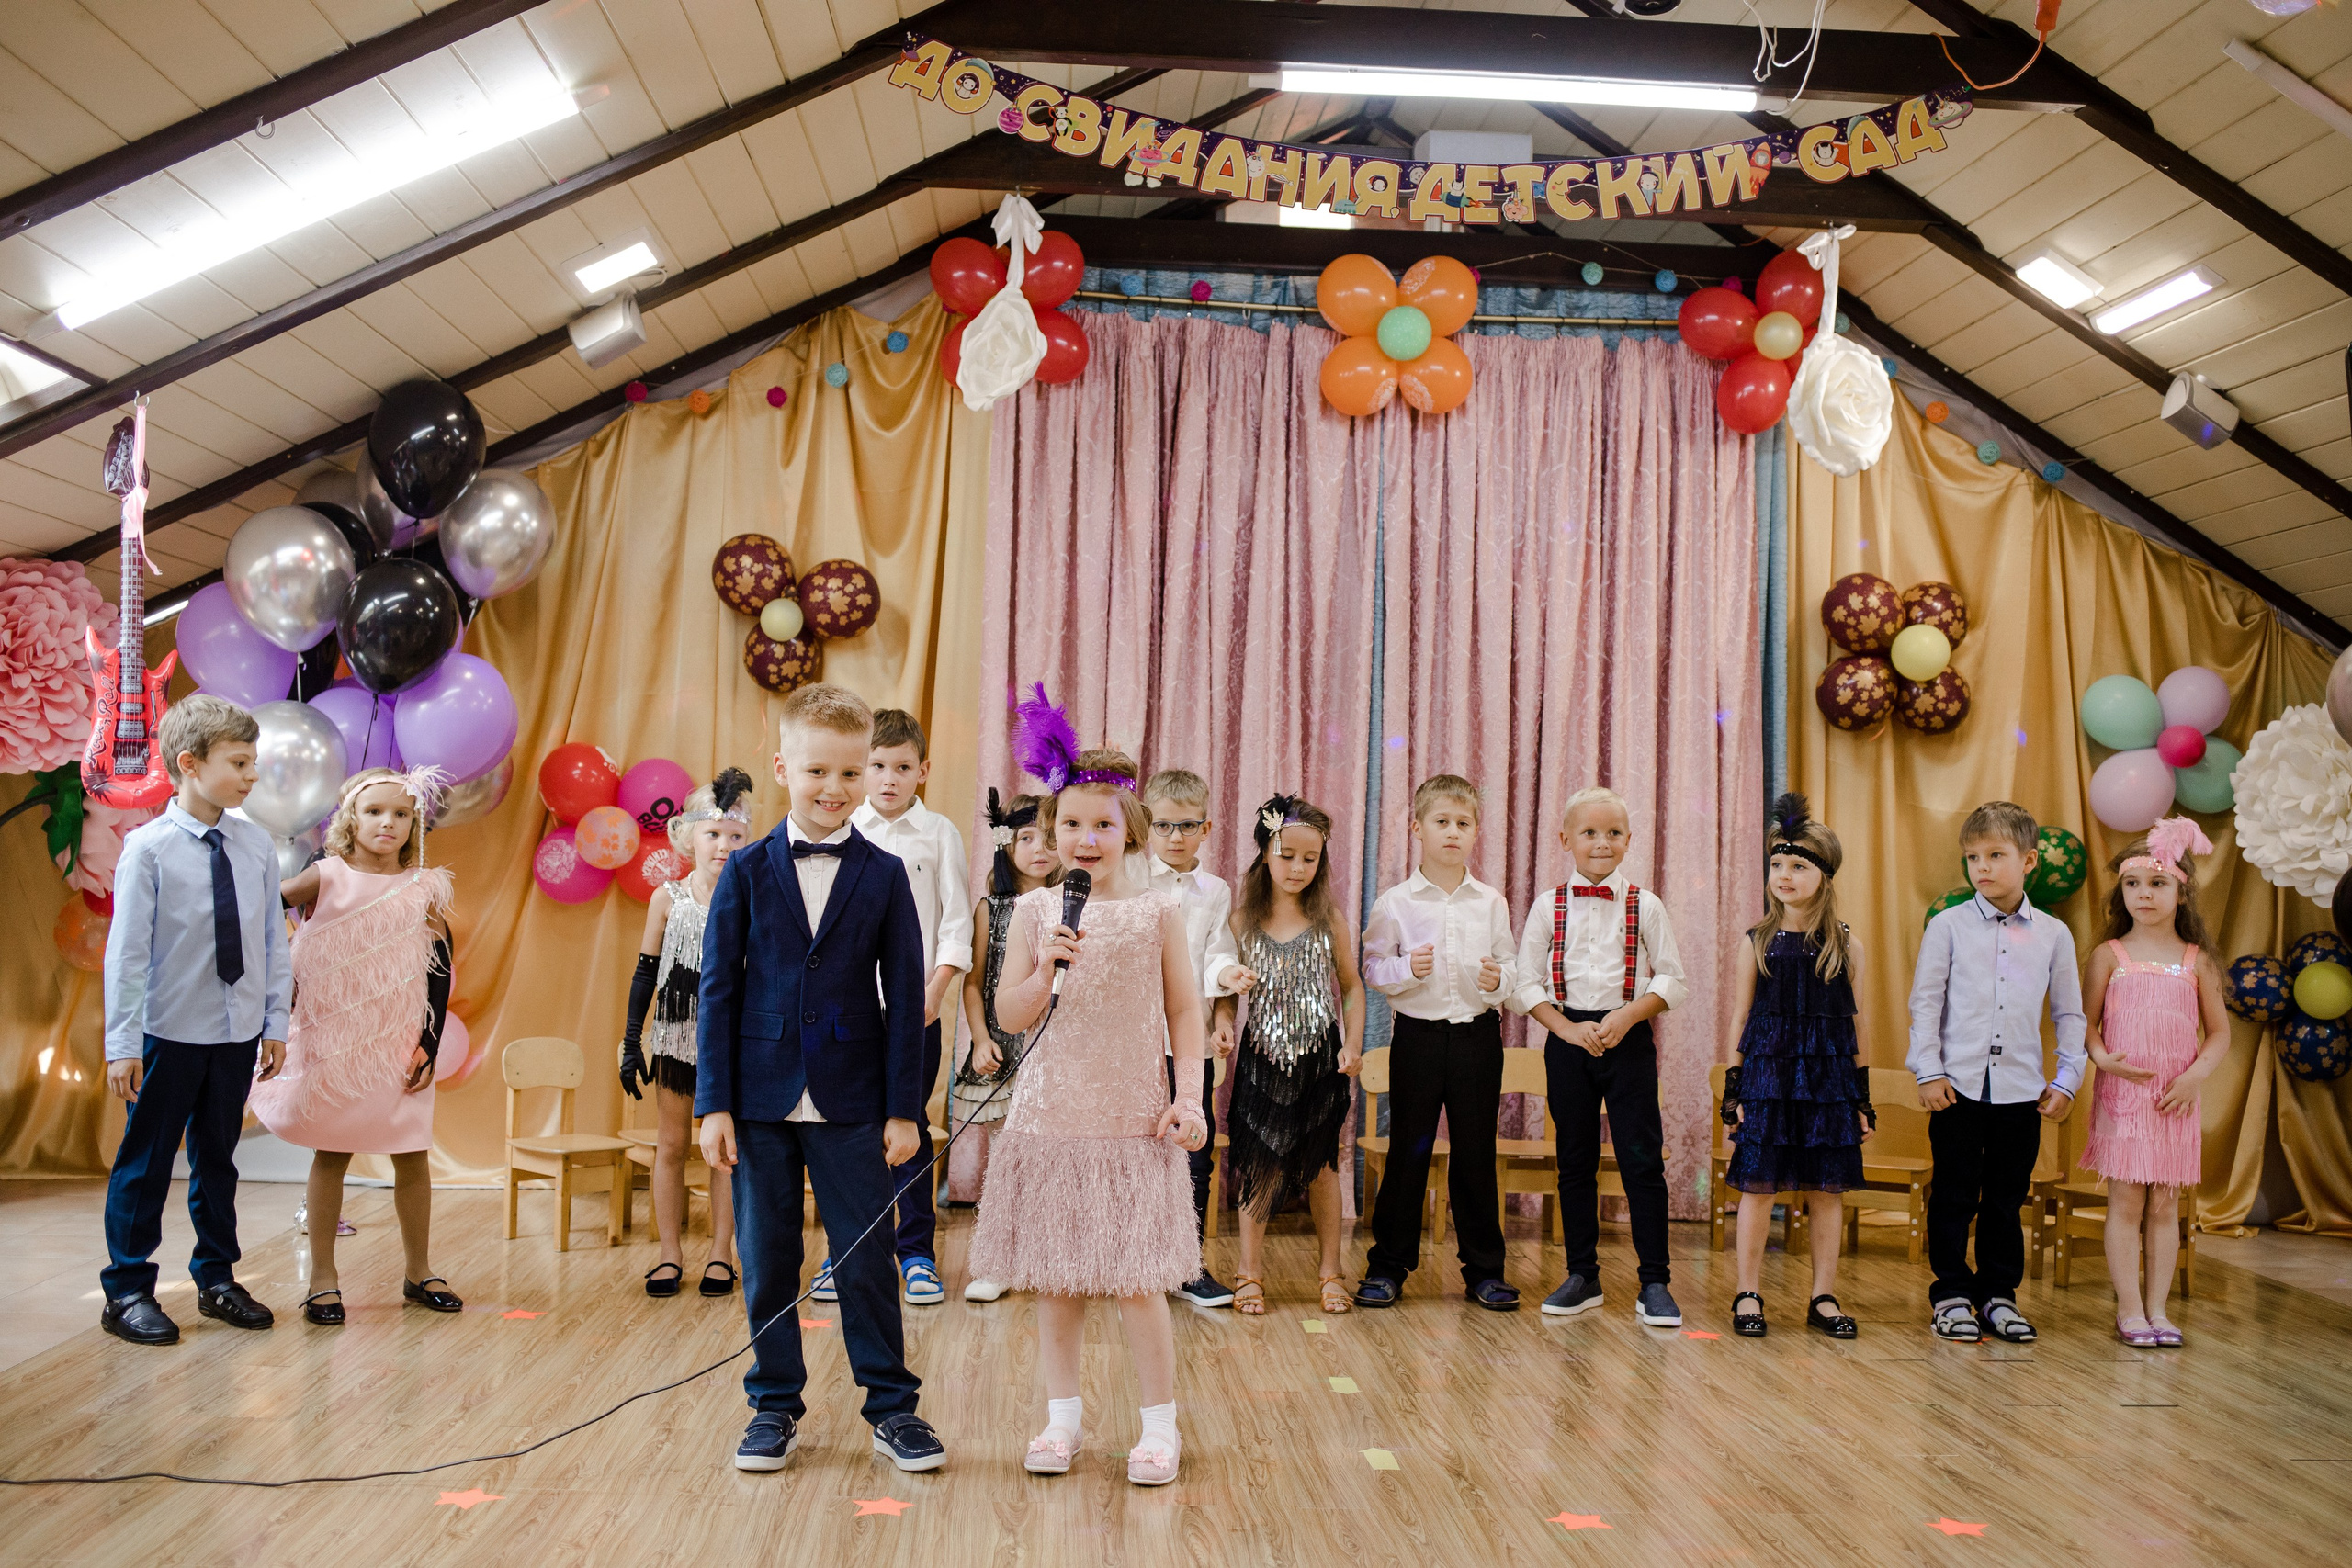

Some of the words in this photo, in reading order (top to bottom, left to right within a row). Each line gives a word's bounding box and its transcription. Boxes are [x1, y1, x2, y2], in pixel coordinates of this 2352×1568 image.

[888, 39, 995, 114] ДО
[1408, 143, 1757, 224] ДЕТСКИЙ
[1797, 94, 1949, 184] САД
